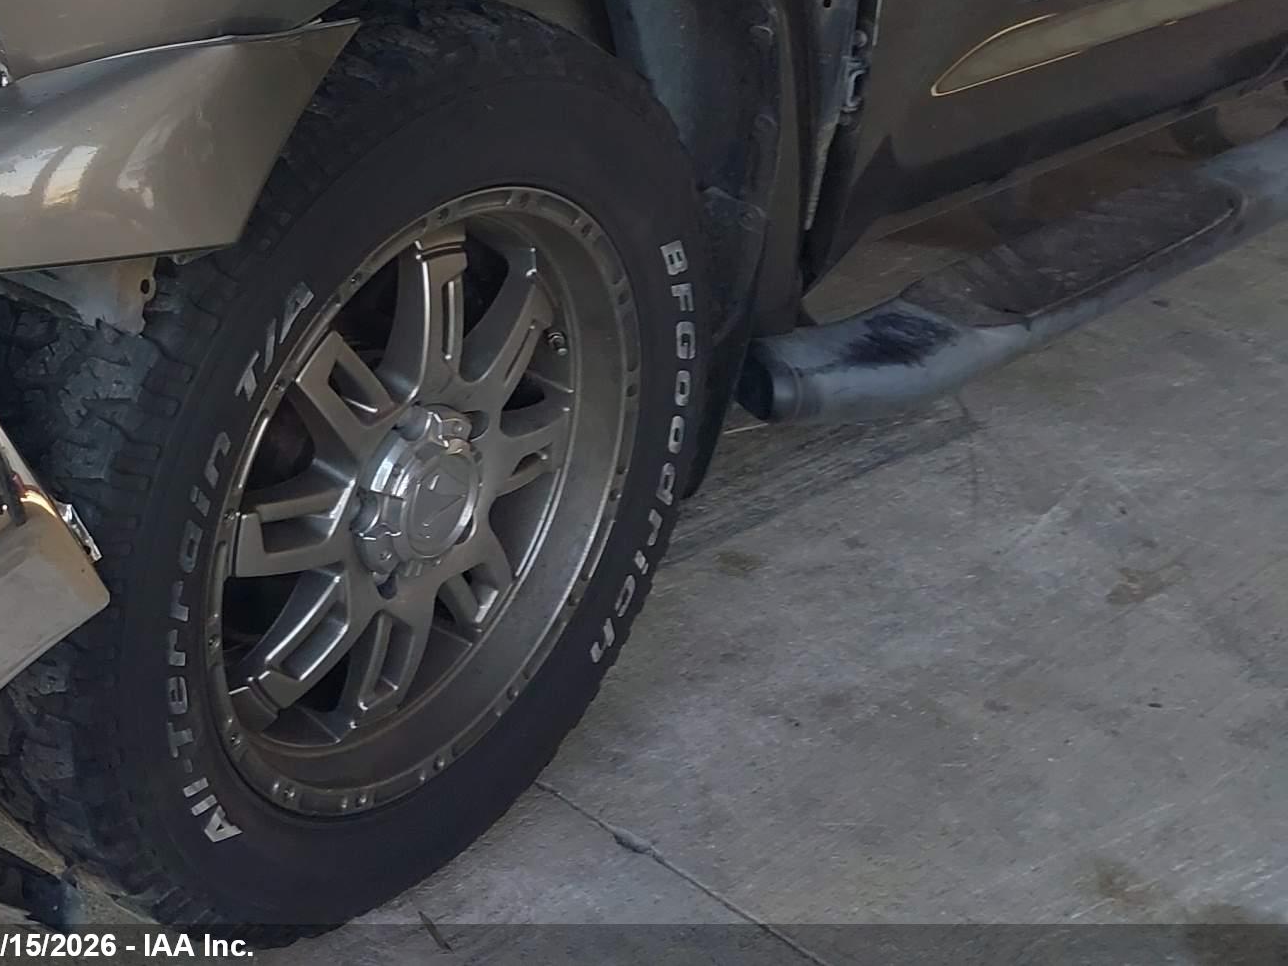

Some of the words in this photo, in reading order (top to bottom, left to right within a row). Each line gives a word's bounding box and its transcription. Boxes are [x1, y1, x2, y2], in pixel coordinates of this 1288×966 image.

[165, 431, 244, 844] All-Terrain
[235, 280, 315, 402] T/A
[589, 239, 697, 664] BFGoodrich
